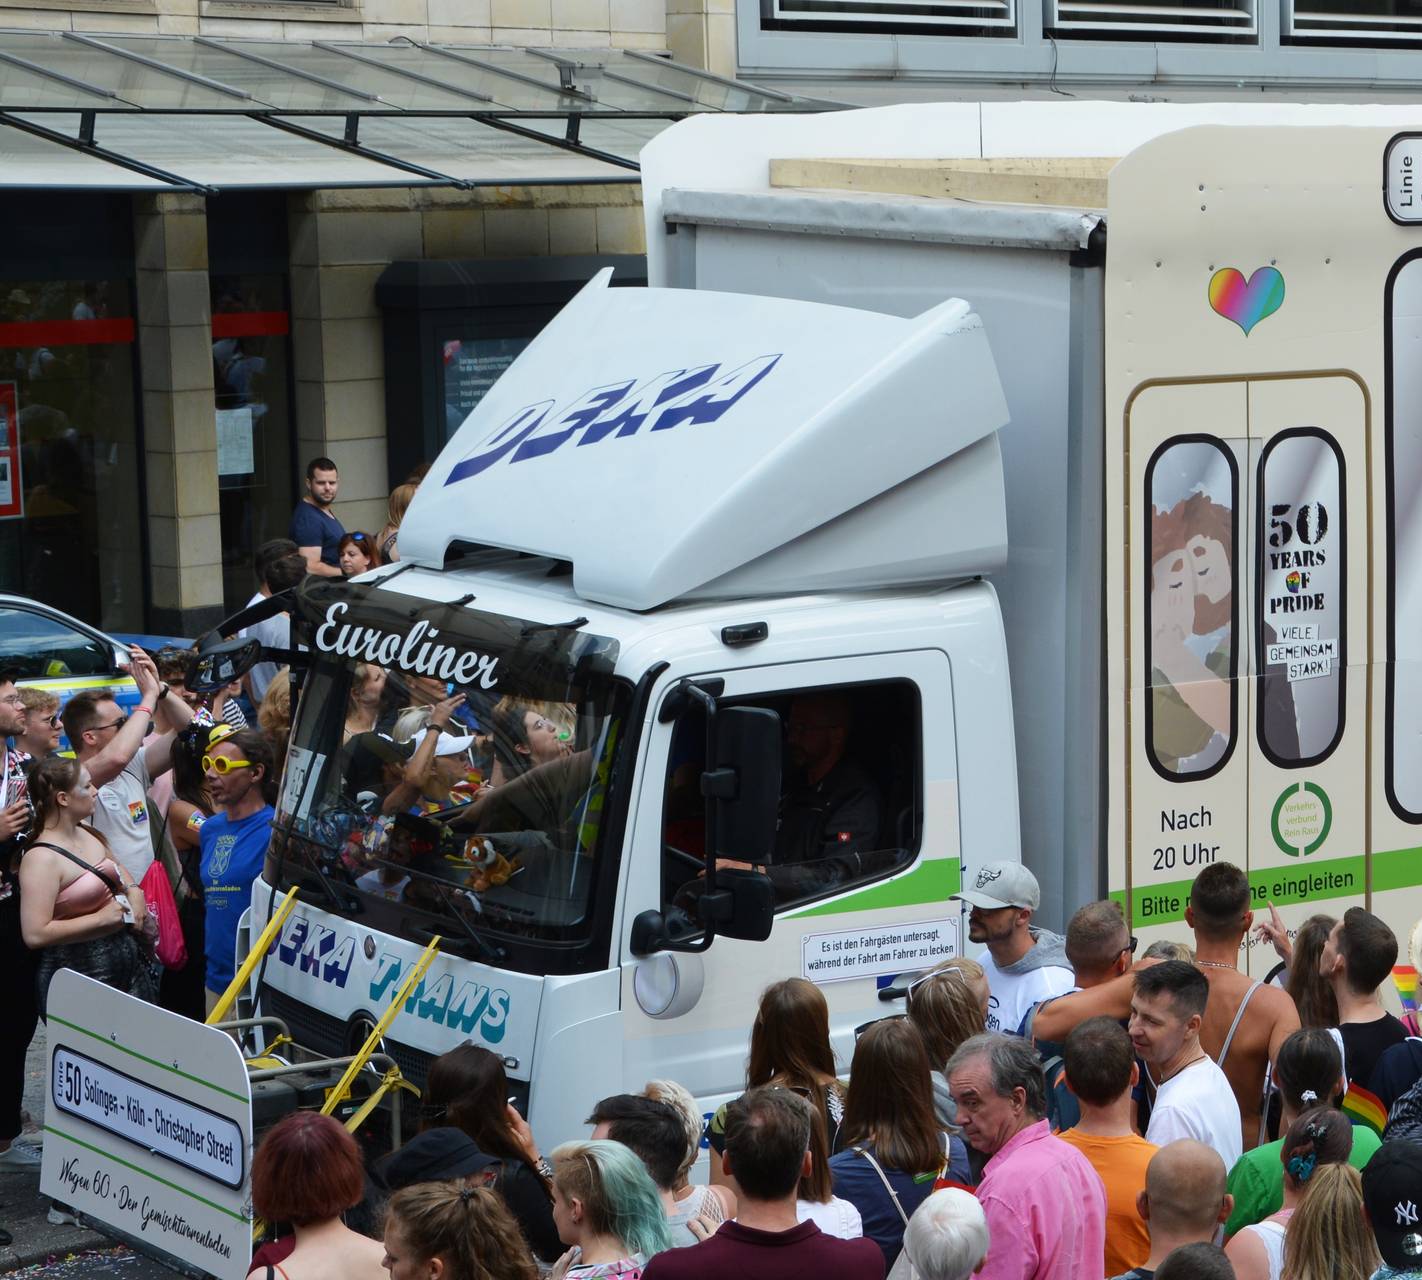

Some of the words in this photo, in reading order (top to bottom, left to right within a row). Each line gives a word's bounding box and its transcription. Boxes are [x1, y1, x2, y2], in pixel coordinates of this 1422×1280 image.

[1400, 155, 1413, 207] Linie
[443, 354, 783, 487] DEKA
[1269, 501, 1328, 547] 50
[1270, 549, 1326, 570] YEARS
[1270, 593, 1324, 613] PRIDE
[316, 602, 499, 689] Euroliner
[1290, 660, 1328, 678] STARK!
[1161, 805, 1212, 832] Nach
[1153, 847, 1176, 870] 20
[1183, 843, 1220, 866] Uhr
[1142, 895, 1180, 917] Bitte
[1273, 873, 1354, 898] eingleiten
[807, 955, 841, 971] während
[843, 954, 856, 966] der
[857, 951, 878, 964] Fahrt
[879, 952, 891, 962] am
[892, 946, 917, 960] Fahrer
[918, 946, 928, 957] zu
[929, 943, 954, 956] lecken
[821, 941, 832, 953] Es
[832, 939, 843, 951] ist
[844, 937, 858, 950] den
[860, 933, 901, 949] Fahrgästen
[65, 1062, 81, 1106] 50
[84, 1076, 118, 1117] Solingen
[126, 1096, 145, 1127] Köln
[154, 1108, 205, 1153] Christopher
[207, 1131, 234, 1166] Street
[59, 1157, 90, 1194] Wagen
[92, 1170, 111, 1199] 60
[117, 1185, 138, 1212] Der
[141, 1195, 232, 1259] Gemischtwarenladen
[1394, 1200, 1418, 1225] NY
